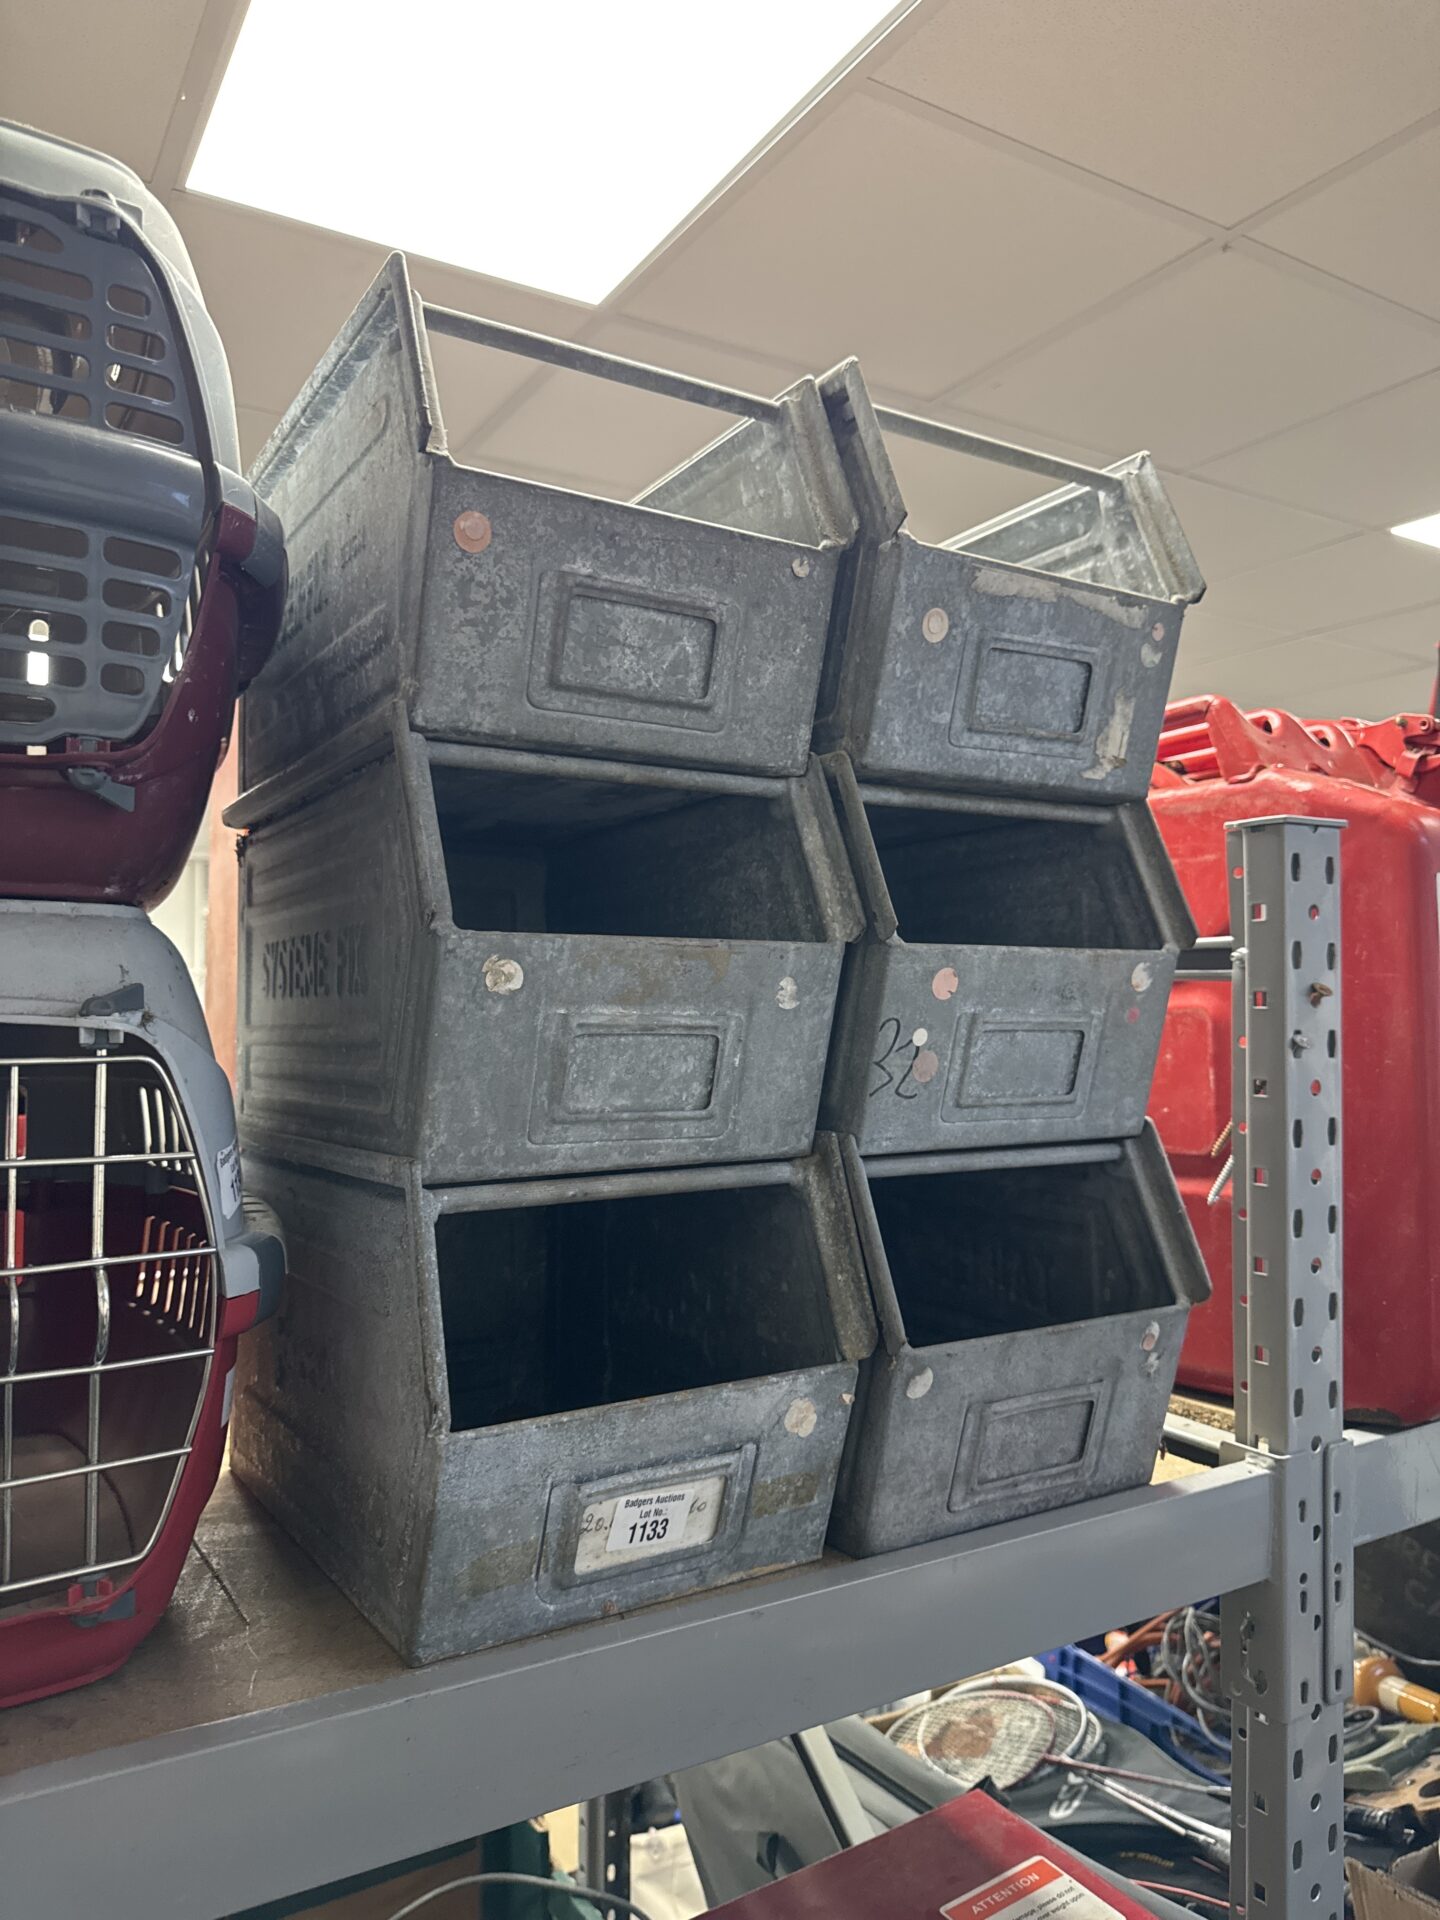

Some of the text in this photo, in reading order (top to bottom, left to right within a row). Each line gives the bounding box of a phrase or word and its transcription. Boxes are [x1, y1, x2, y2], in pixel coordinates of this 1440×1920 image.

[262, 929, 331, 999] SYSTEME
[869, 1017, 918, 1099] 32
[624, 1493, 685, 1508] Badgers Auctions
[640, 1508, 651, 1519] Lot
[629, 1518, 669, 1544] 1133
[971, 1872, 1040, 1915] ATTENTION
